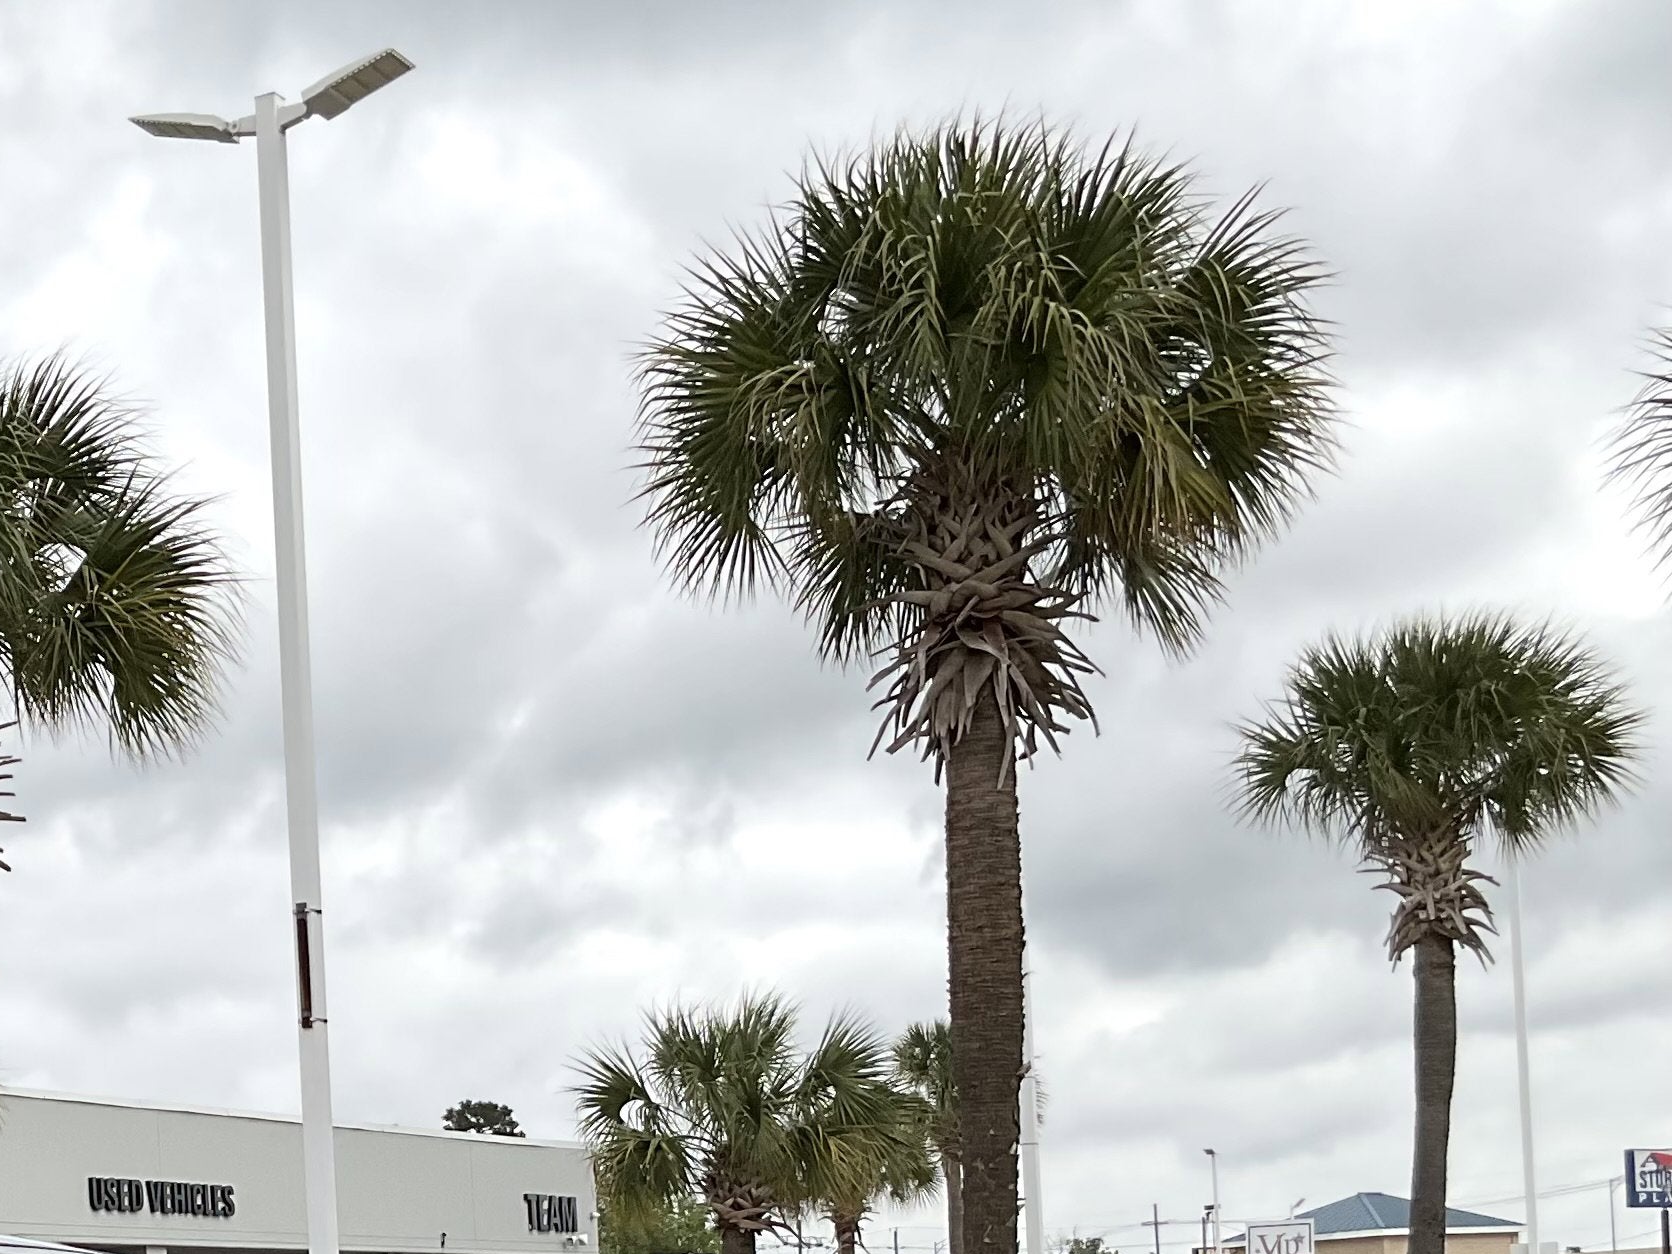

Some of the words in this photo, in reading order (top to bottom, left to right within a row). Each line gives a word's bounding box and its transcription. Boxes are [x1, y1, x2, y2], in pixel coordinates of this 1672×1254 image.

[88, 1177, 144, 1213] USED
[145, 1180, 235, 1217] VEHICLES
[523, 1194, 578, 1232] TEAM
